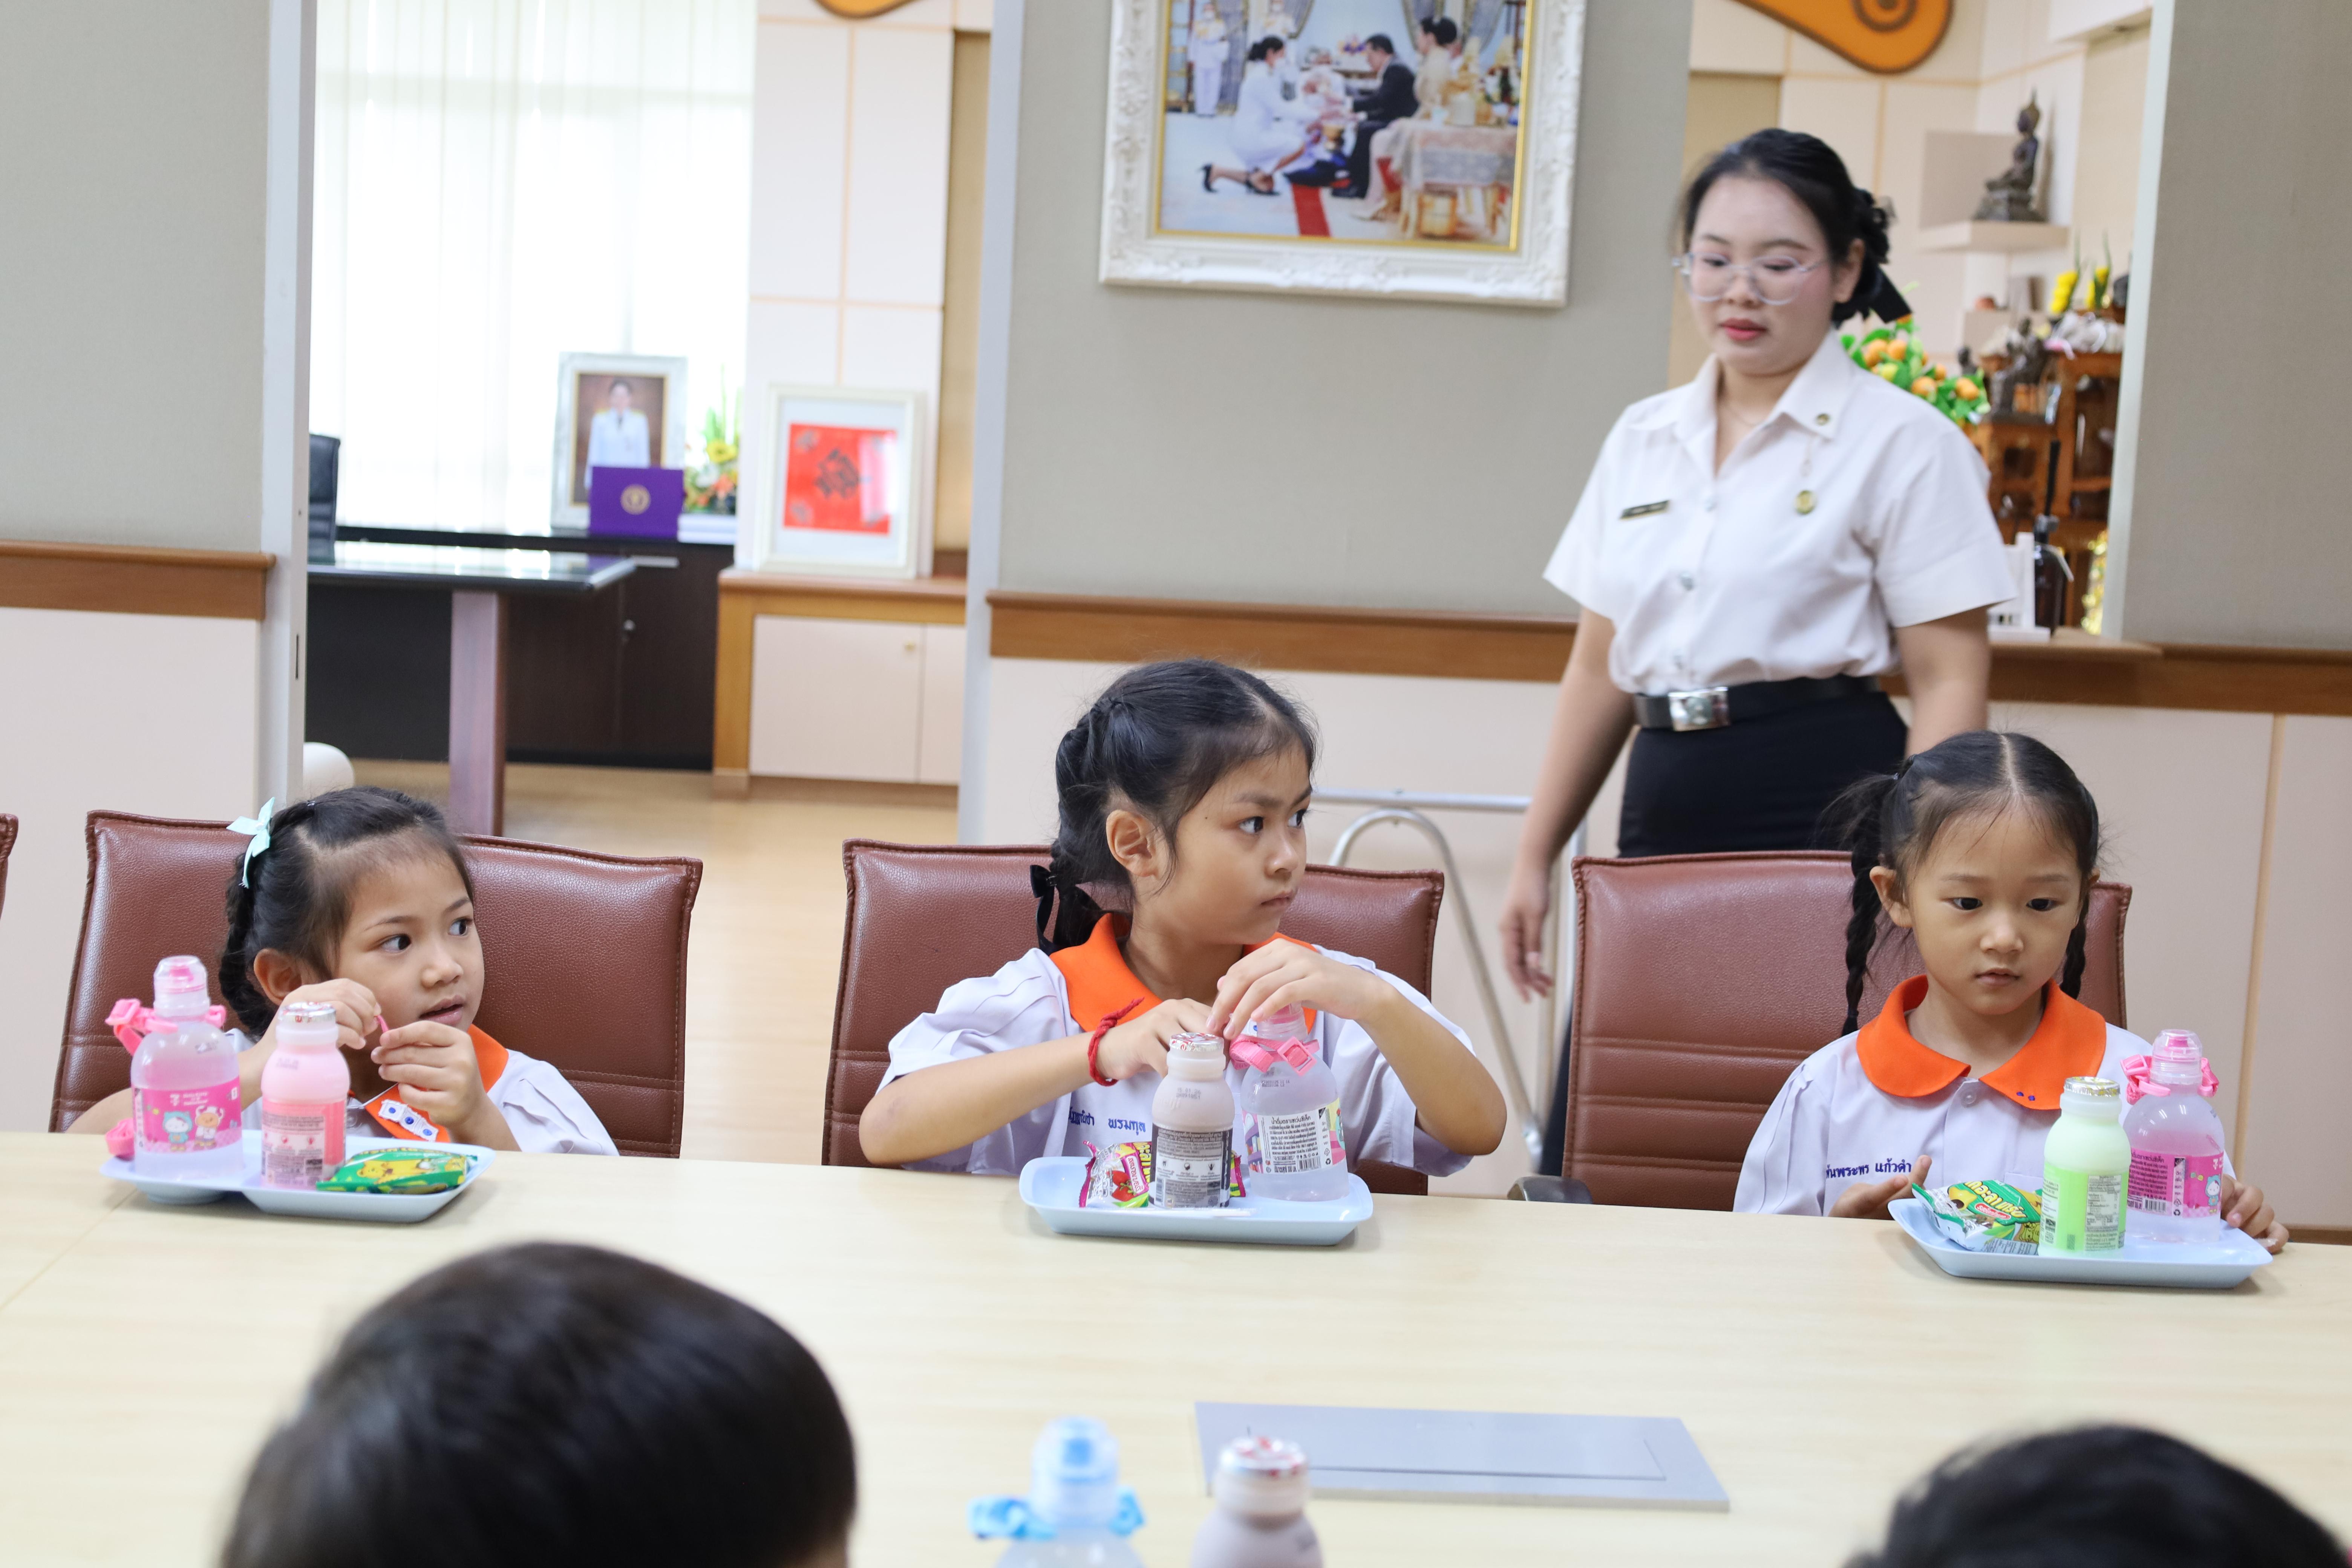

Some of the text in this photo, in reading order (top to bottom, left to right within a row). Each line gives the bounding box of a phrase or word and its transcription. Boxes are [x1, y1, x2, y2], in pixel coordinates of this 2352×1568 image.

[1108, 1118, 1146, 1135] พรมกุล
[1875, 1158, 1911, 1173] แก้วคำ
